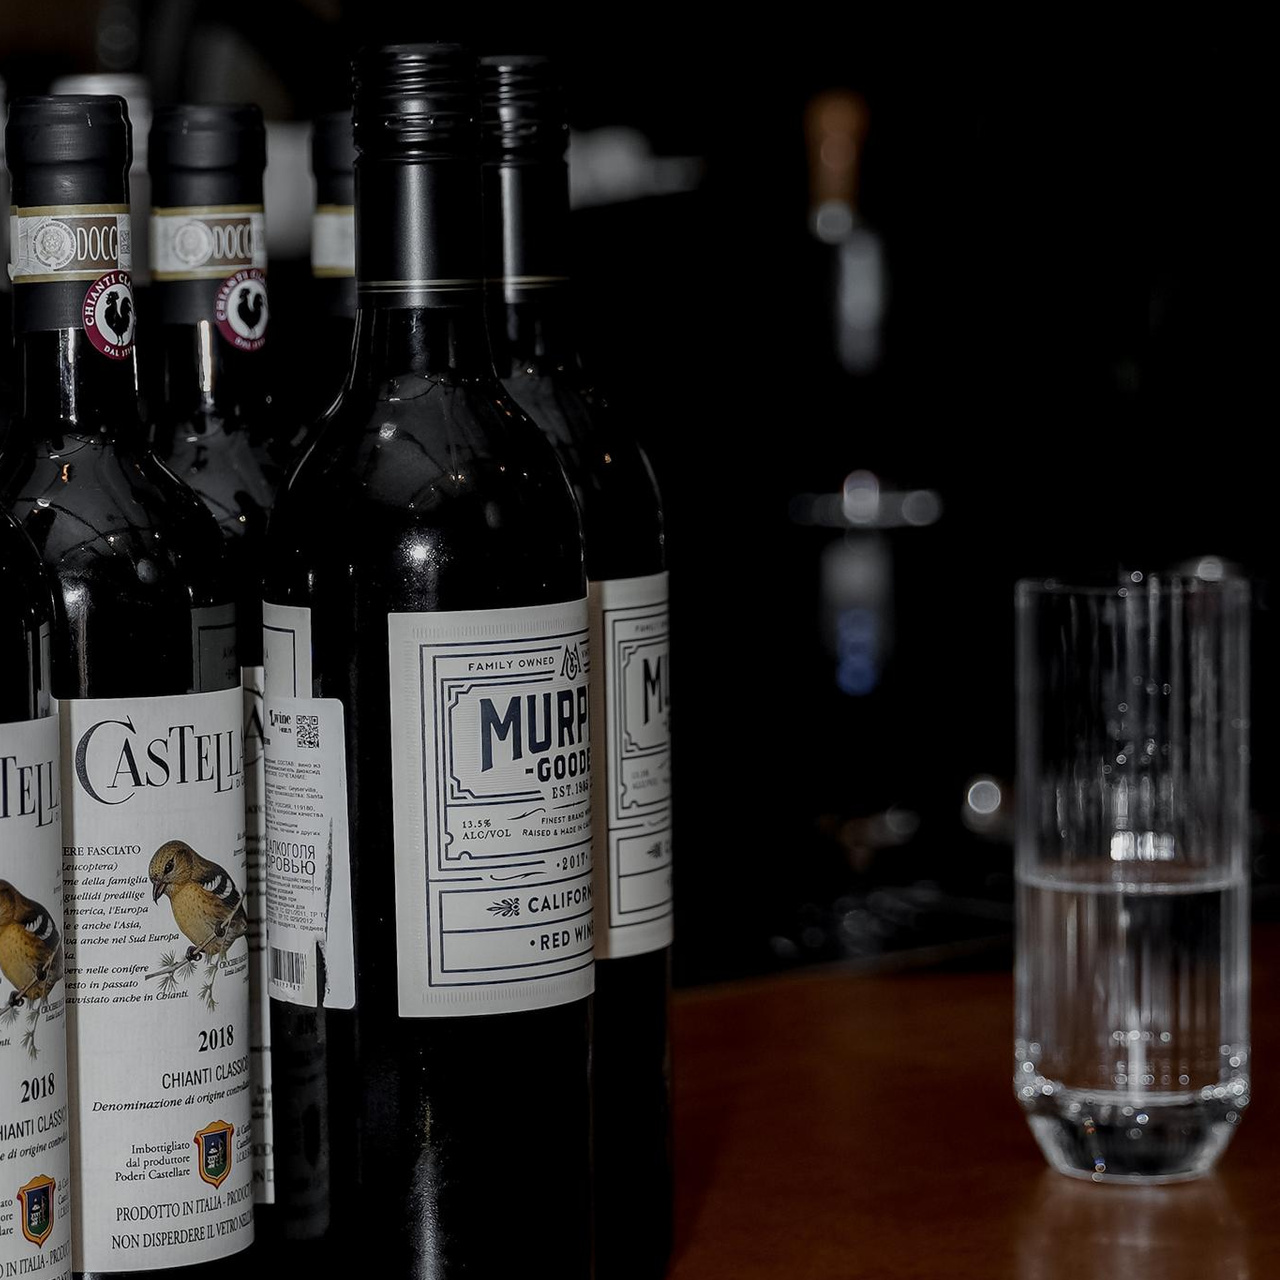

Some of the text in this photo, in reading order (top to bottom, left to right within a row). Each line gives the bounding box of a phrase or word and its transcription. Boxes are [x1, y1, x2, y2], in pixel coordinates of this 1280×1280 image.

[77, 226, 118, 261] DOCG
[85, 274, 115, 326] CHIANTI
[468, 656, 555, 671] FAMILY OWNED
[480, 684, 591, 772] MURP
[75, 715, 243, 805] CASTELL
[462, 819, 492, 829] 13.5%
[541, 815, 566, 824] FINEST
[462, 829, 512, 840] ALC/VOL
[522, 828, 551, 837] RAISED
[62, 845, 141, 856] ERE FASCIATO
[81, 876, 106, 886] della
[106, 876, 148, 889] famiglia
[63, 890, 146, 904] guellidi predilige
[63, 905, 149, 917] America, l'Europa
[82, 921, 111, 930] anche
[113, 920, 142, 931] l'Asia,
[80, 936, 109, 945] anche
[112, 935, 127, 944] nel
[128, 934, 146, 943] Sud
[148, 932, 180, 944] Europa
[540, 930, 570, 951] RED
[86, 965, 109, 974] nelle
[111, 964, 149, 976] conifere
[89, 979, 139, 991] in passato
[65, 995, 111, 1004] avvistato
[113, 993, 142, 1003] anche
[143, 992, 153, 1001] in
[198, 1024, 234, 1053] 2018
[162, 1067, 212, 1089] CHIANTI
[21, 1072, 55, 1103] 2018
[92, 1090, 225, 1112] Denominazione di origine
[7, 1148, 17, 1160] di
[19, 1142, 47, 1158] origine
[131, 1141, 190, 1155] Imbottigliato
[126, 1155, 191, 1169] dal produttore
[115, 1168, 191, 1182] Poderi Castellare
[116, 1195, 222, 1222] PRODOTTO IN ITALIA
[112, 1217, 238, 1250] NON DISPERDERE IL VETRO
[6, 1260, 17, 1277] IN
[20, 1253, 45, 1275] ITALIA
